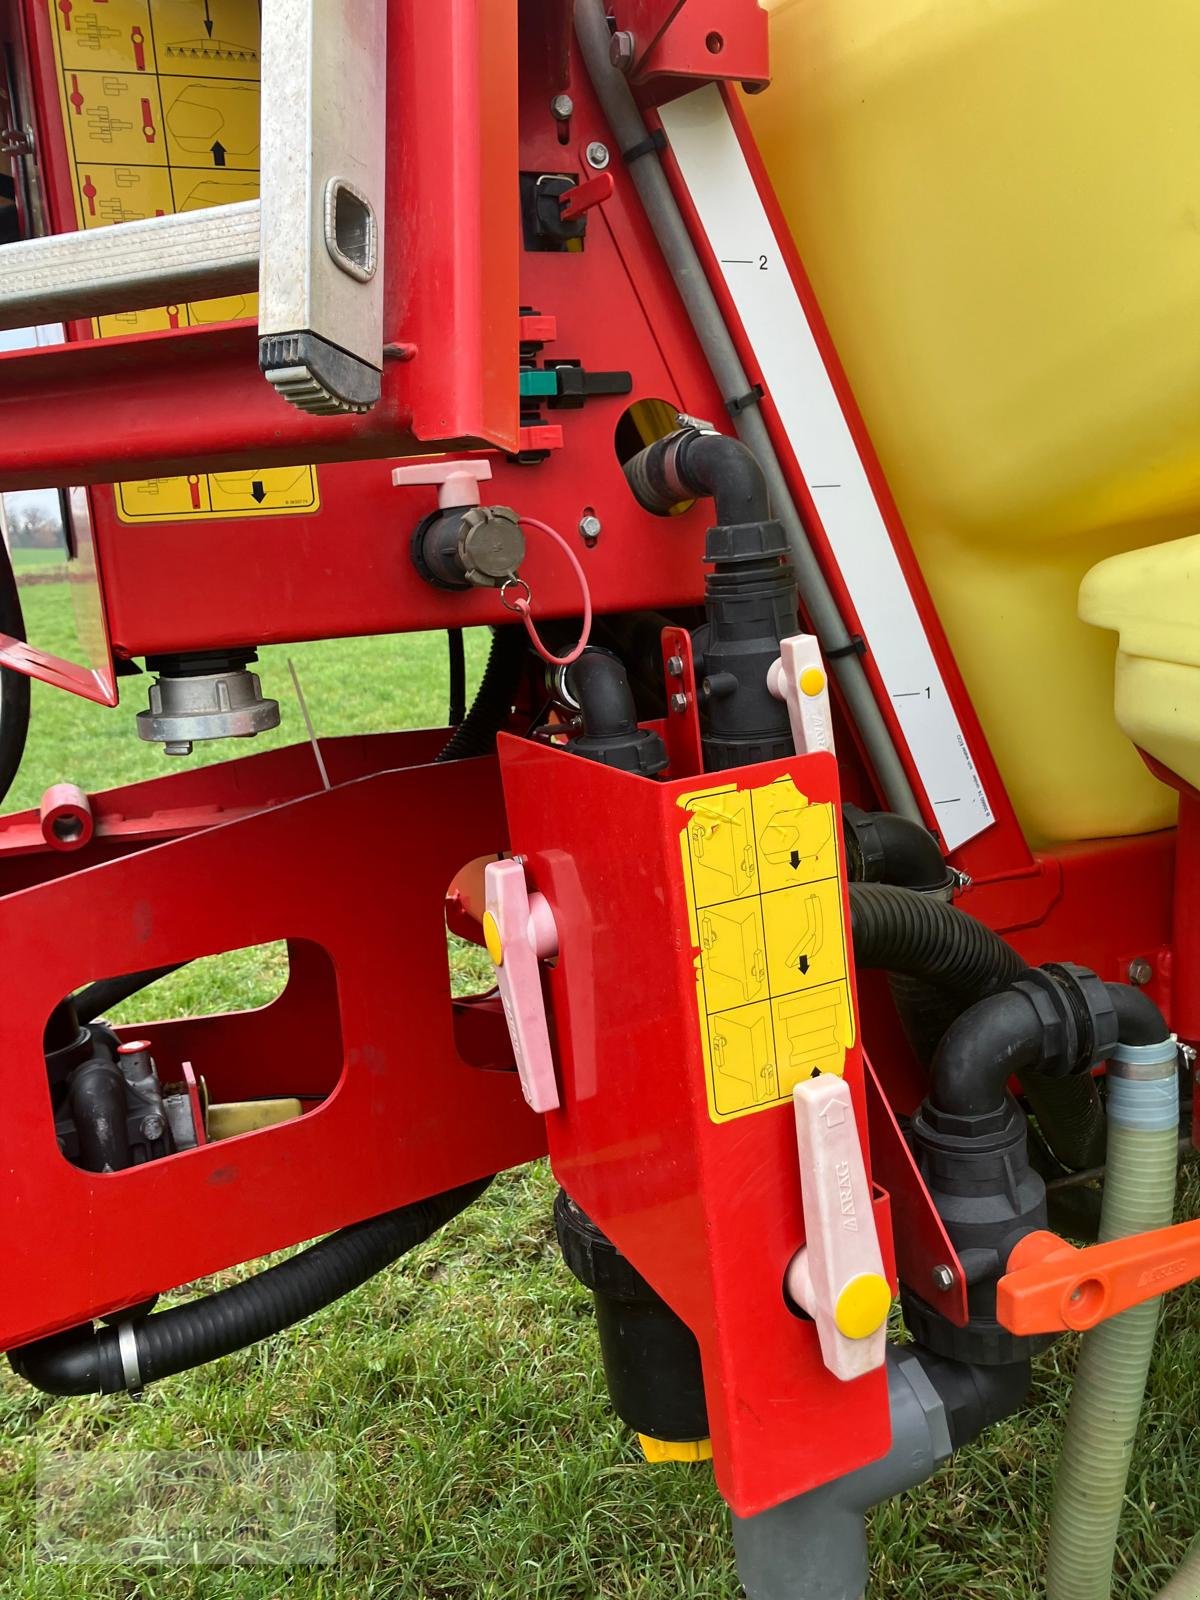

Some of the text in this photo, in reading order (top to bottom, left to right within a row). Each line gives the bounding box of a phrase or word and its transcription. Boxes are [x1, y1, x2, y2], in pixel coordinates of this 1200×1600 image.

[759, 255, 768, 270] 2
[924, 686, 931, 699] 1
[835, 1160, 856, 1216] ARAG
